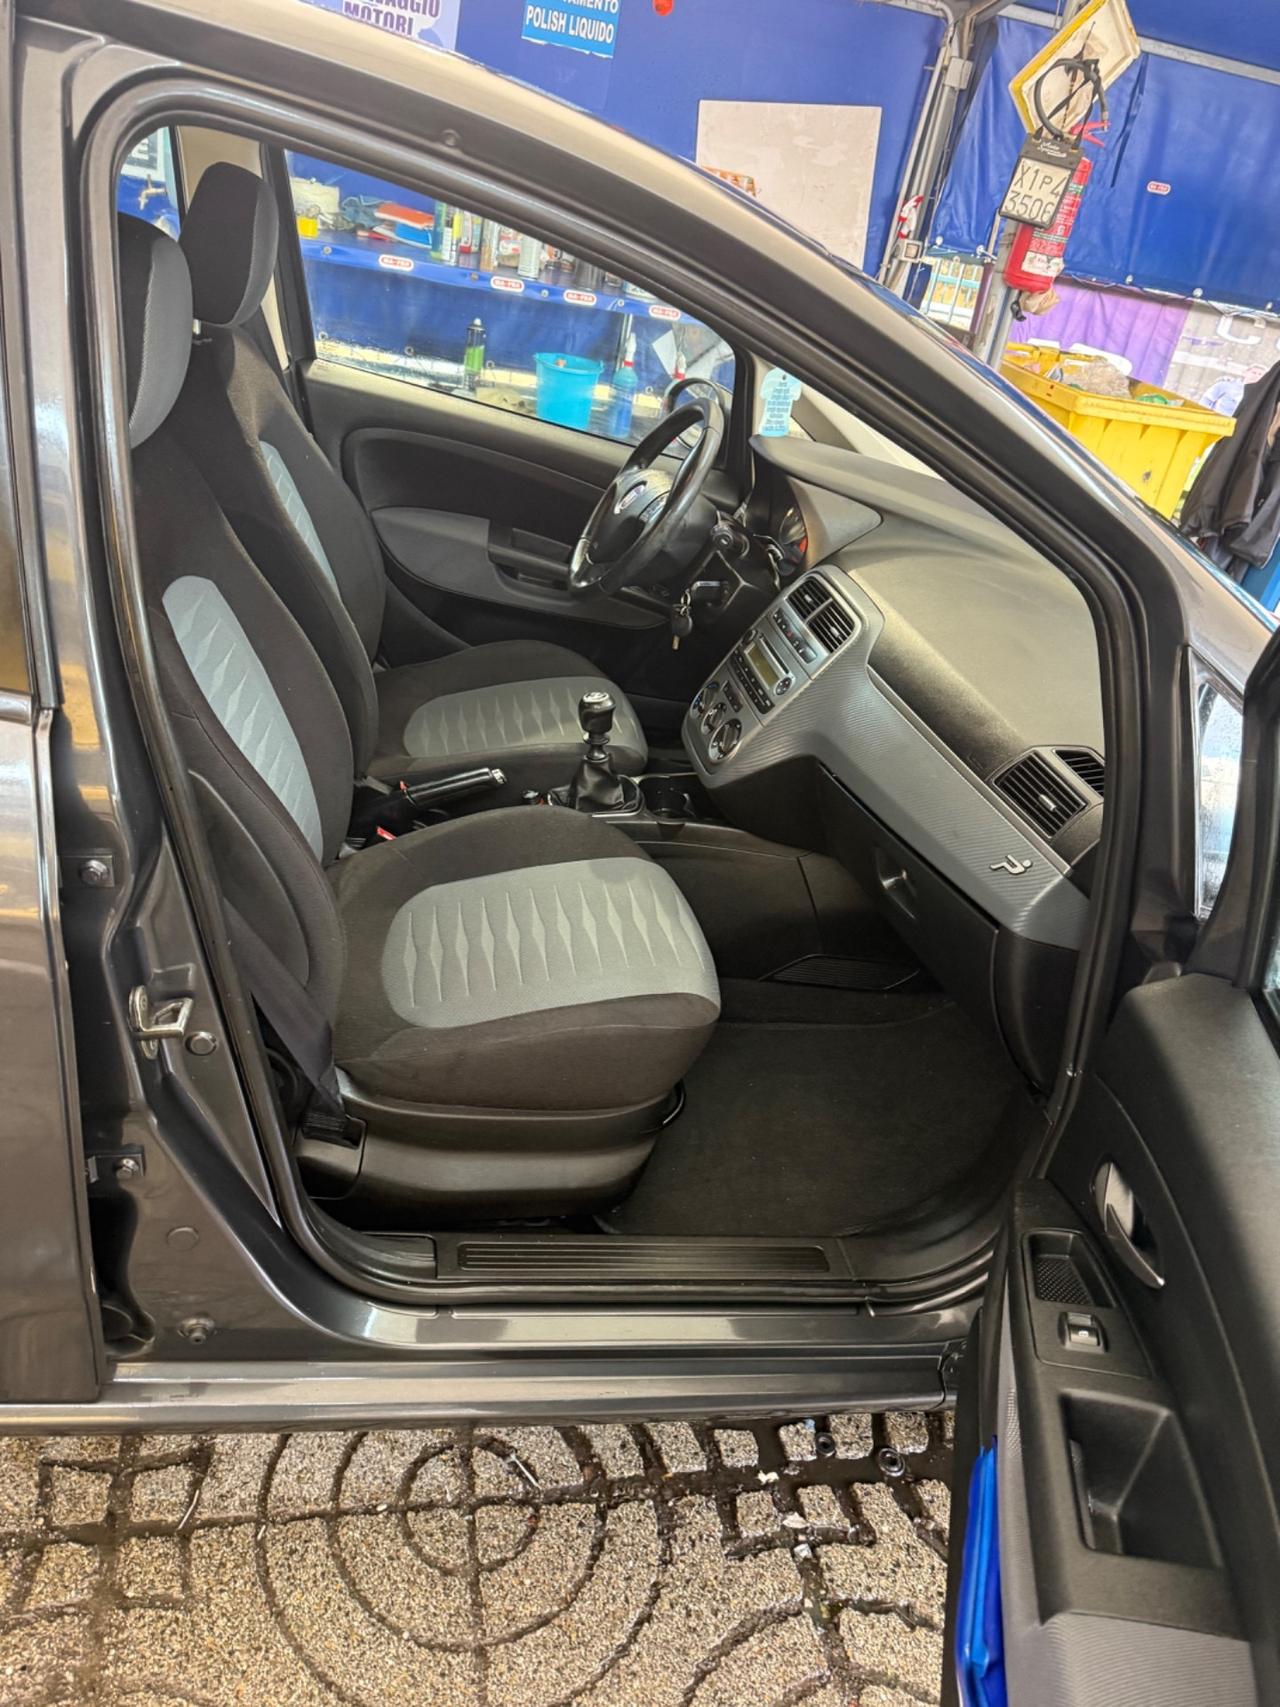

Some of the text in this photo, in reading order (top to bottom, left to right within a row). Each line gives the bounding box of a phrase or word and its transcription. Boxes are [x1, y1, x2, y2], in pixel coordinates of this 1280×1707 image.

[344, 2, 414, 36] MOTORI
[526, 5, 614, 44] POLISH LIQUIDO
